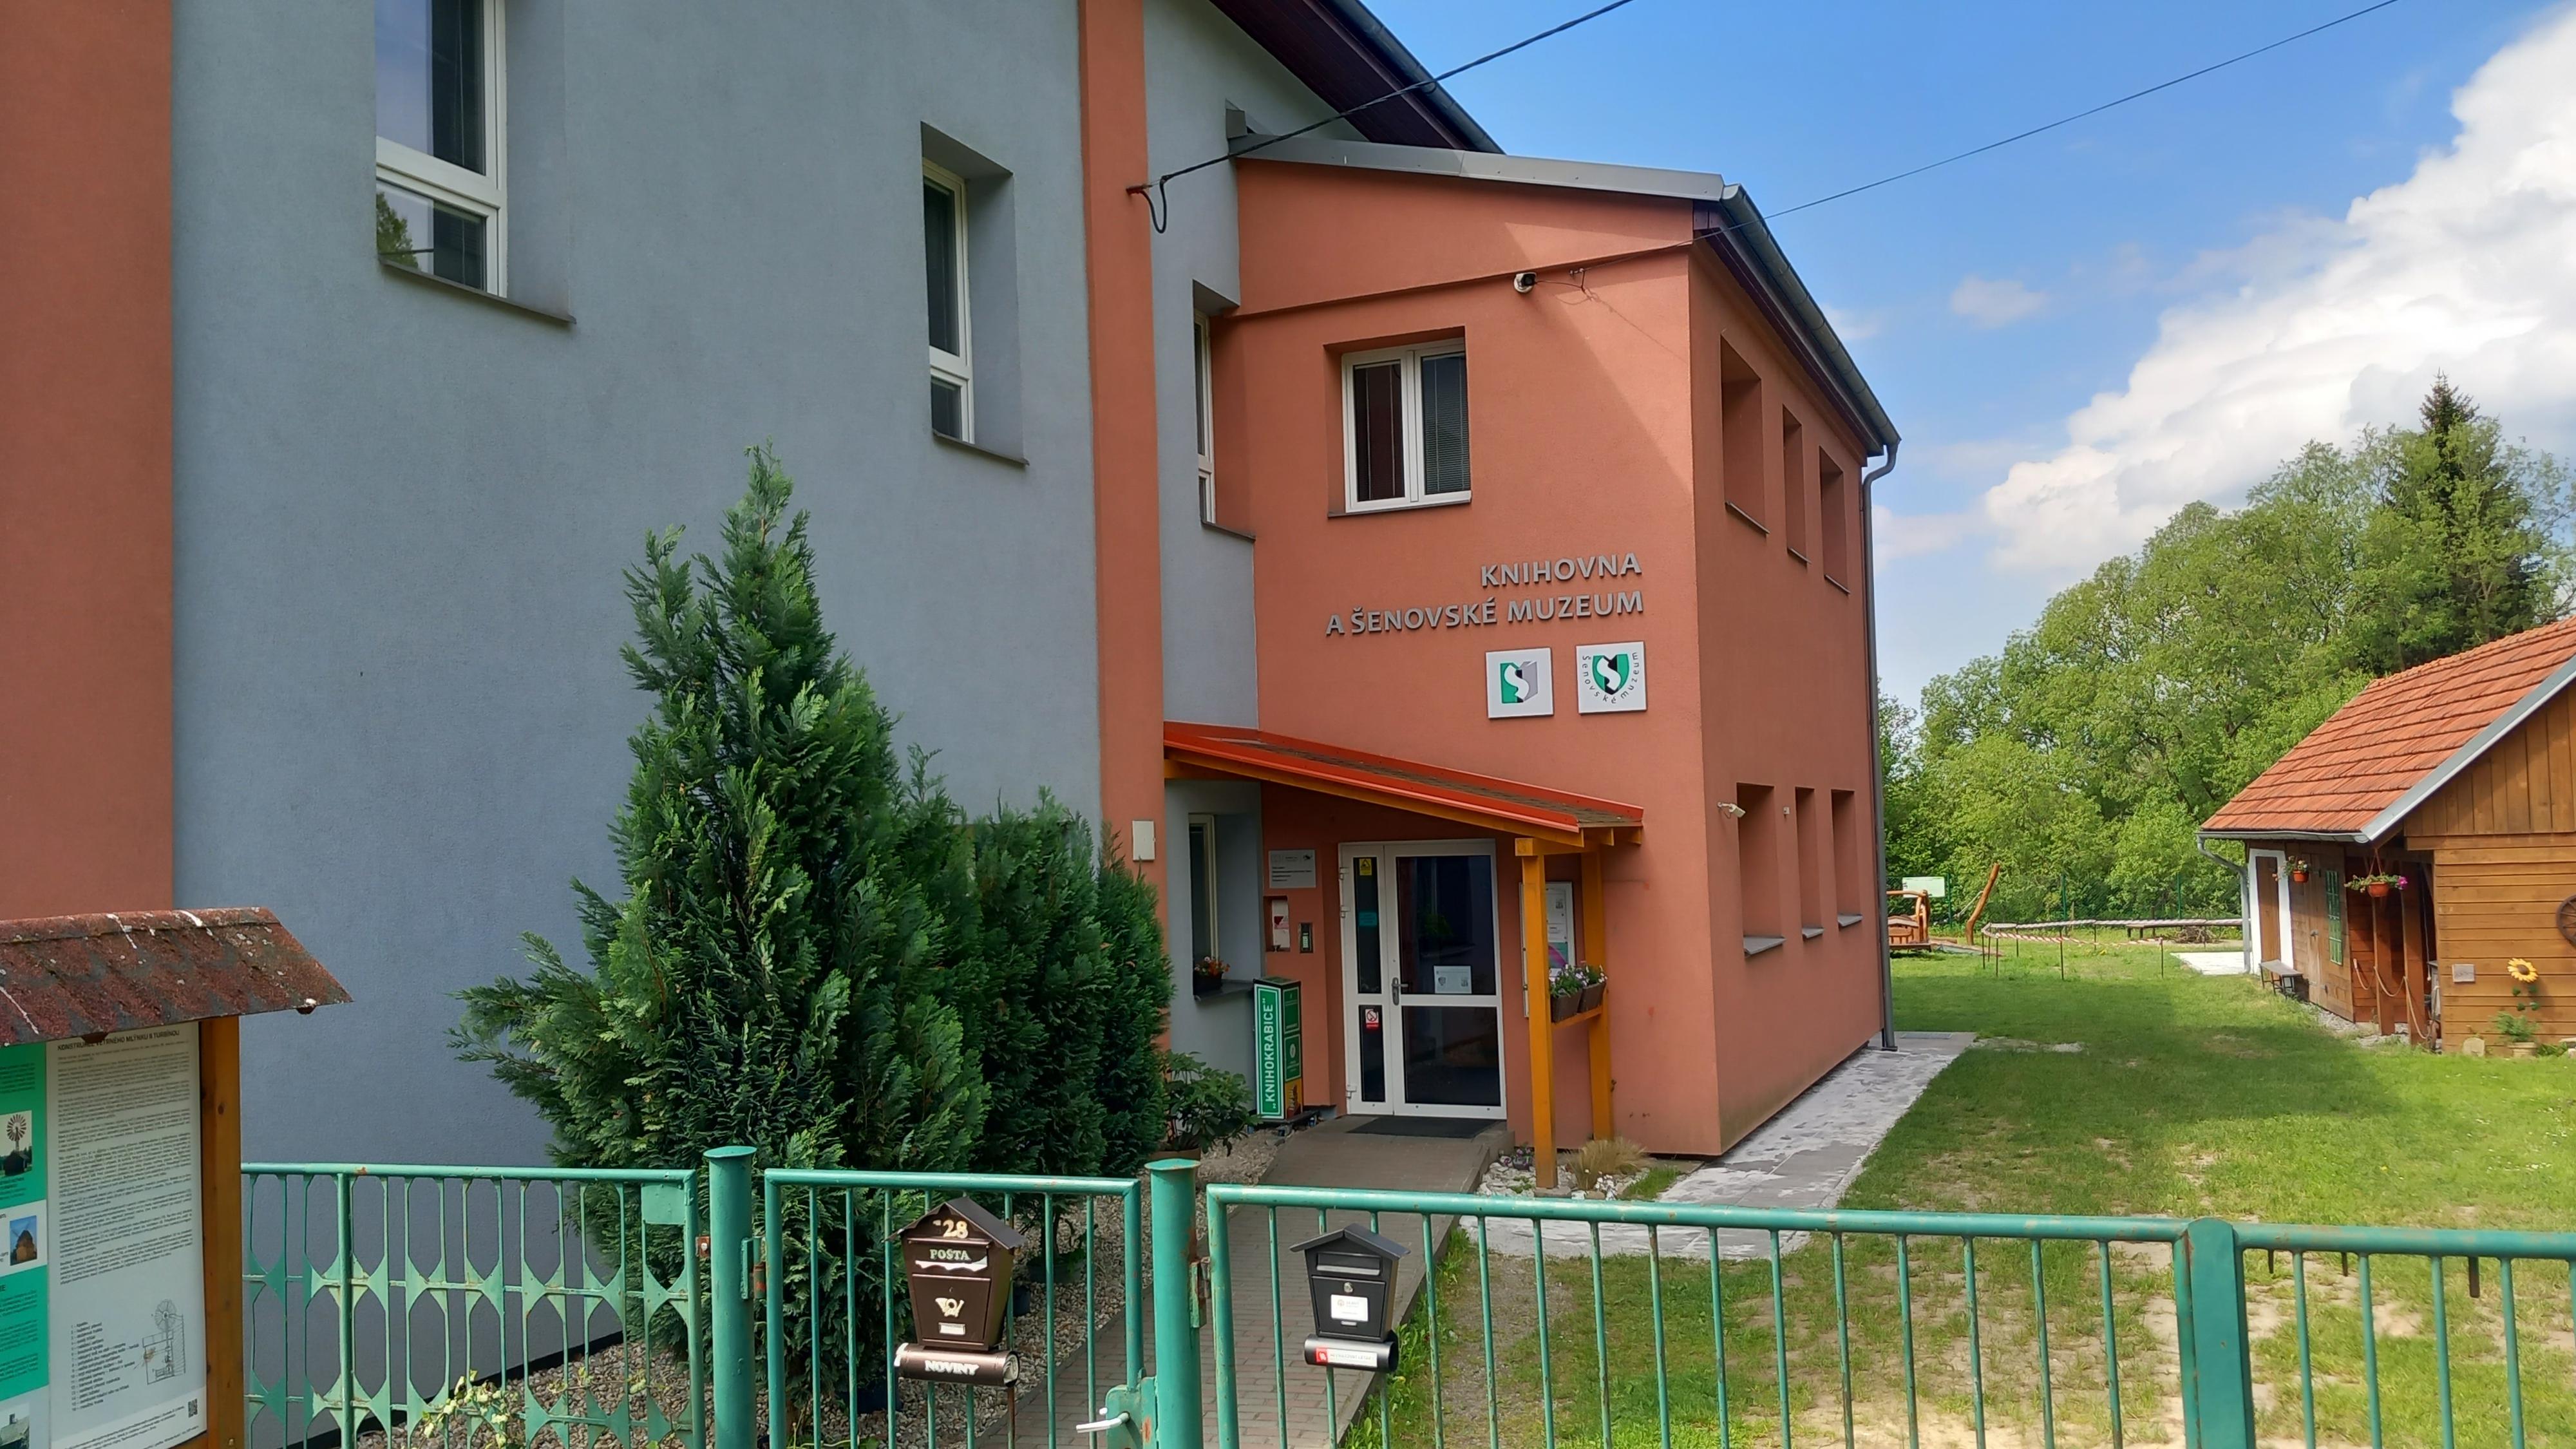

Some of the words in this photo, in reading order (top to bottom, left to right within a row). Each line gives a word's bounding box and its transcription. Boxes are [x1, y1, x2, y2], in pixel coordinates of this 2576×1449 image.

[1481, 552, 1642, 587] KNIHOVNA
[1325, 613, 1345, 636] A
[1350, 596, 1498, 634] ŠENOVSKÉ
[1507, 591, 1643, 622] MUZEUM
[924, 1359, 980, 1376] NOVINY
